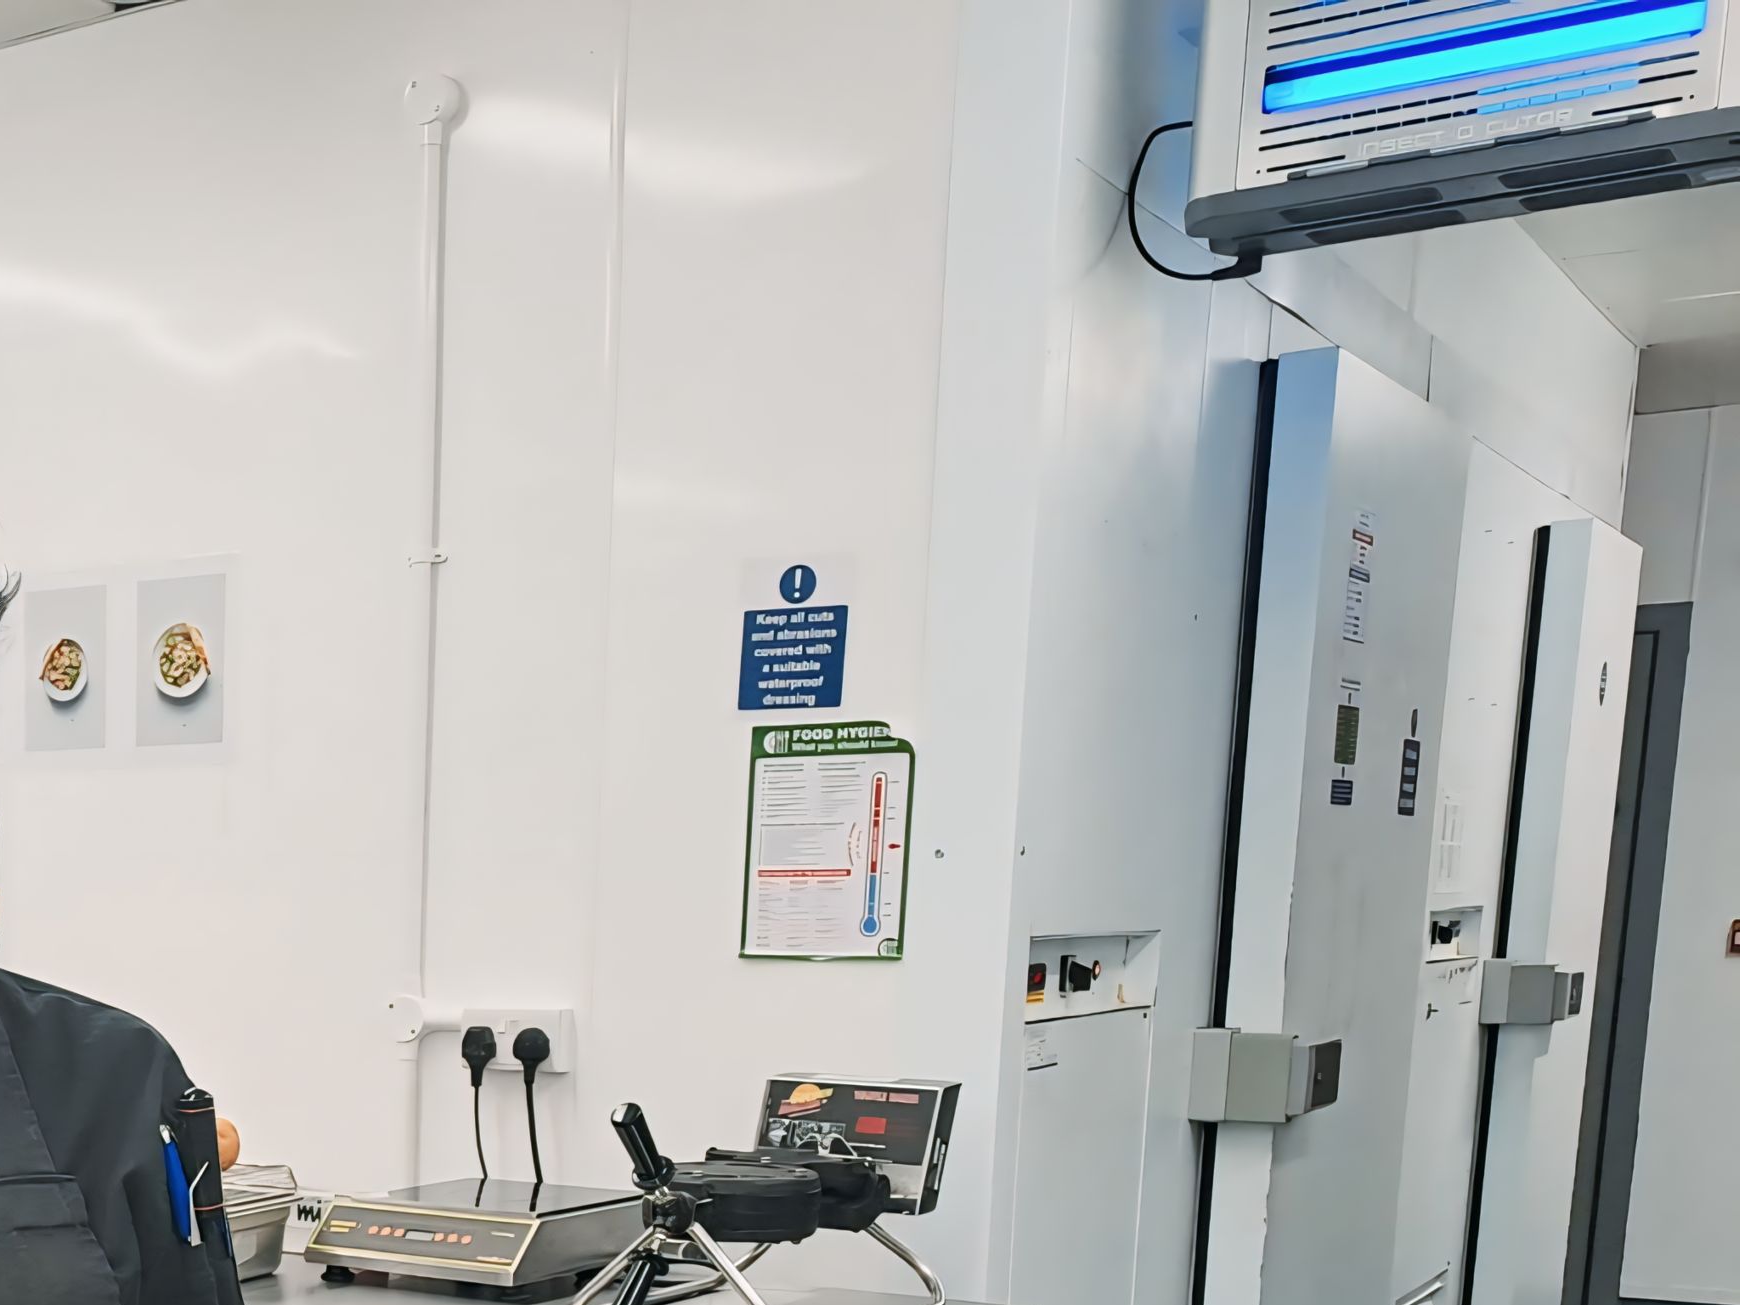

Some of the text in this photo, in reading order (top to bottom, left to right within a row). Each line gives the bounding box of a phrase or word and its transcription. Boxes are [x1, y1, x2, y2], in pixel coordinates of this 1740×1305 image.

[756, 614, 787, 626] Keep
[790, 612, 805, 623] all
[754, 643, 832, 656] covered with
[762, 660, 821, 673] a suitable
[758, 676, 824, 690] waterproof
[762, 692, 816, 706] dressing
[792, 729, 834, 741] FOOD
